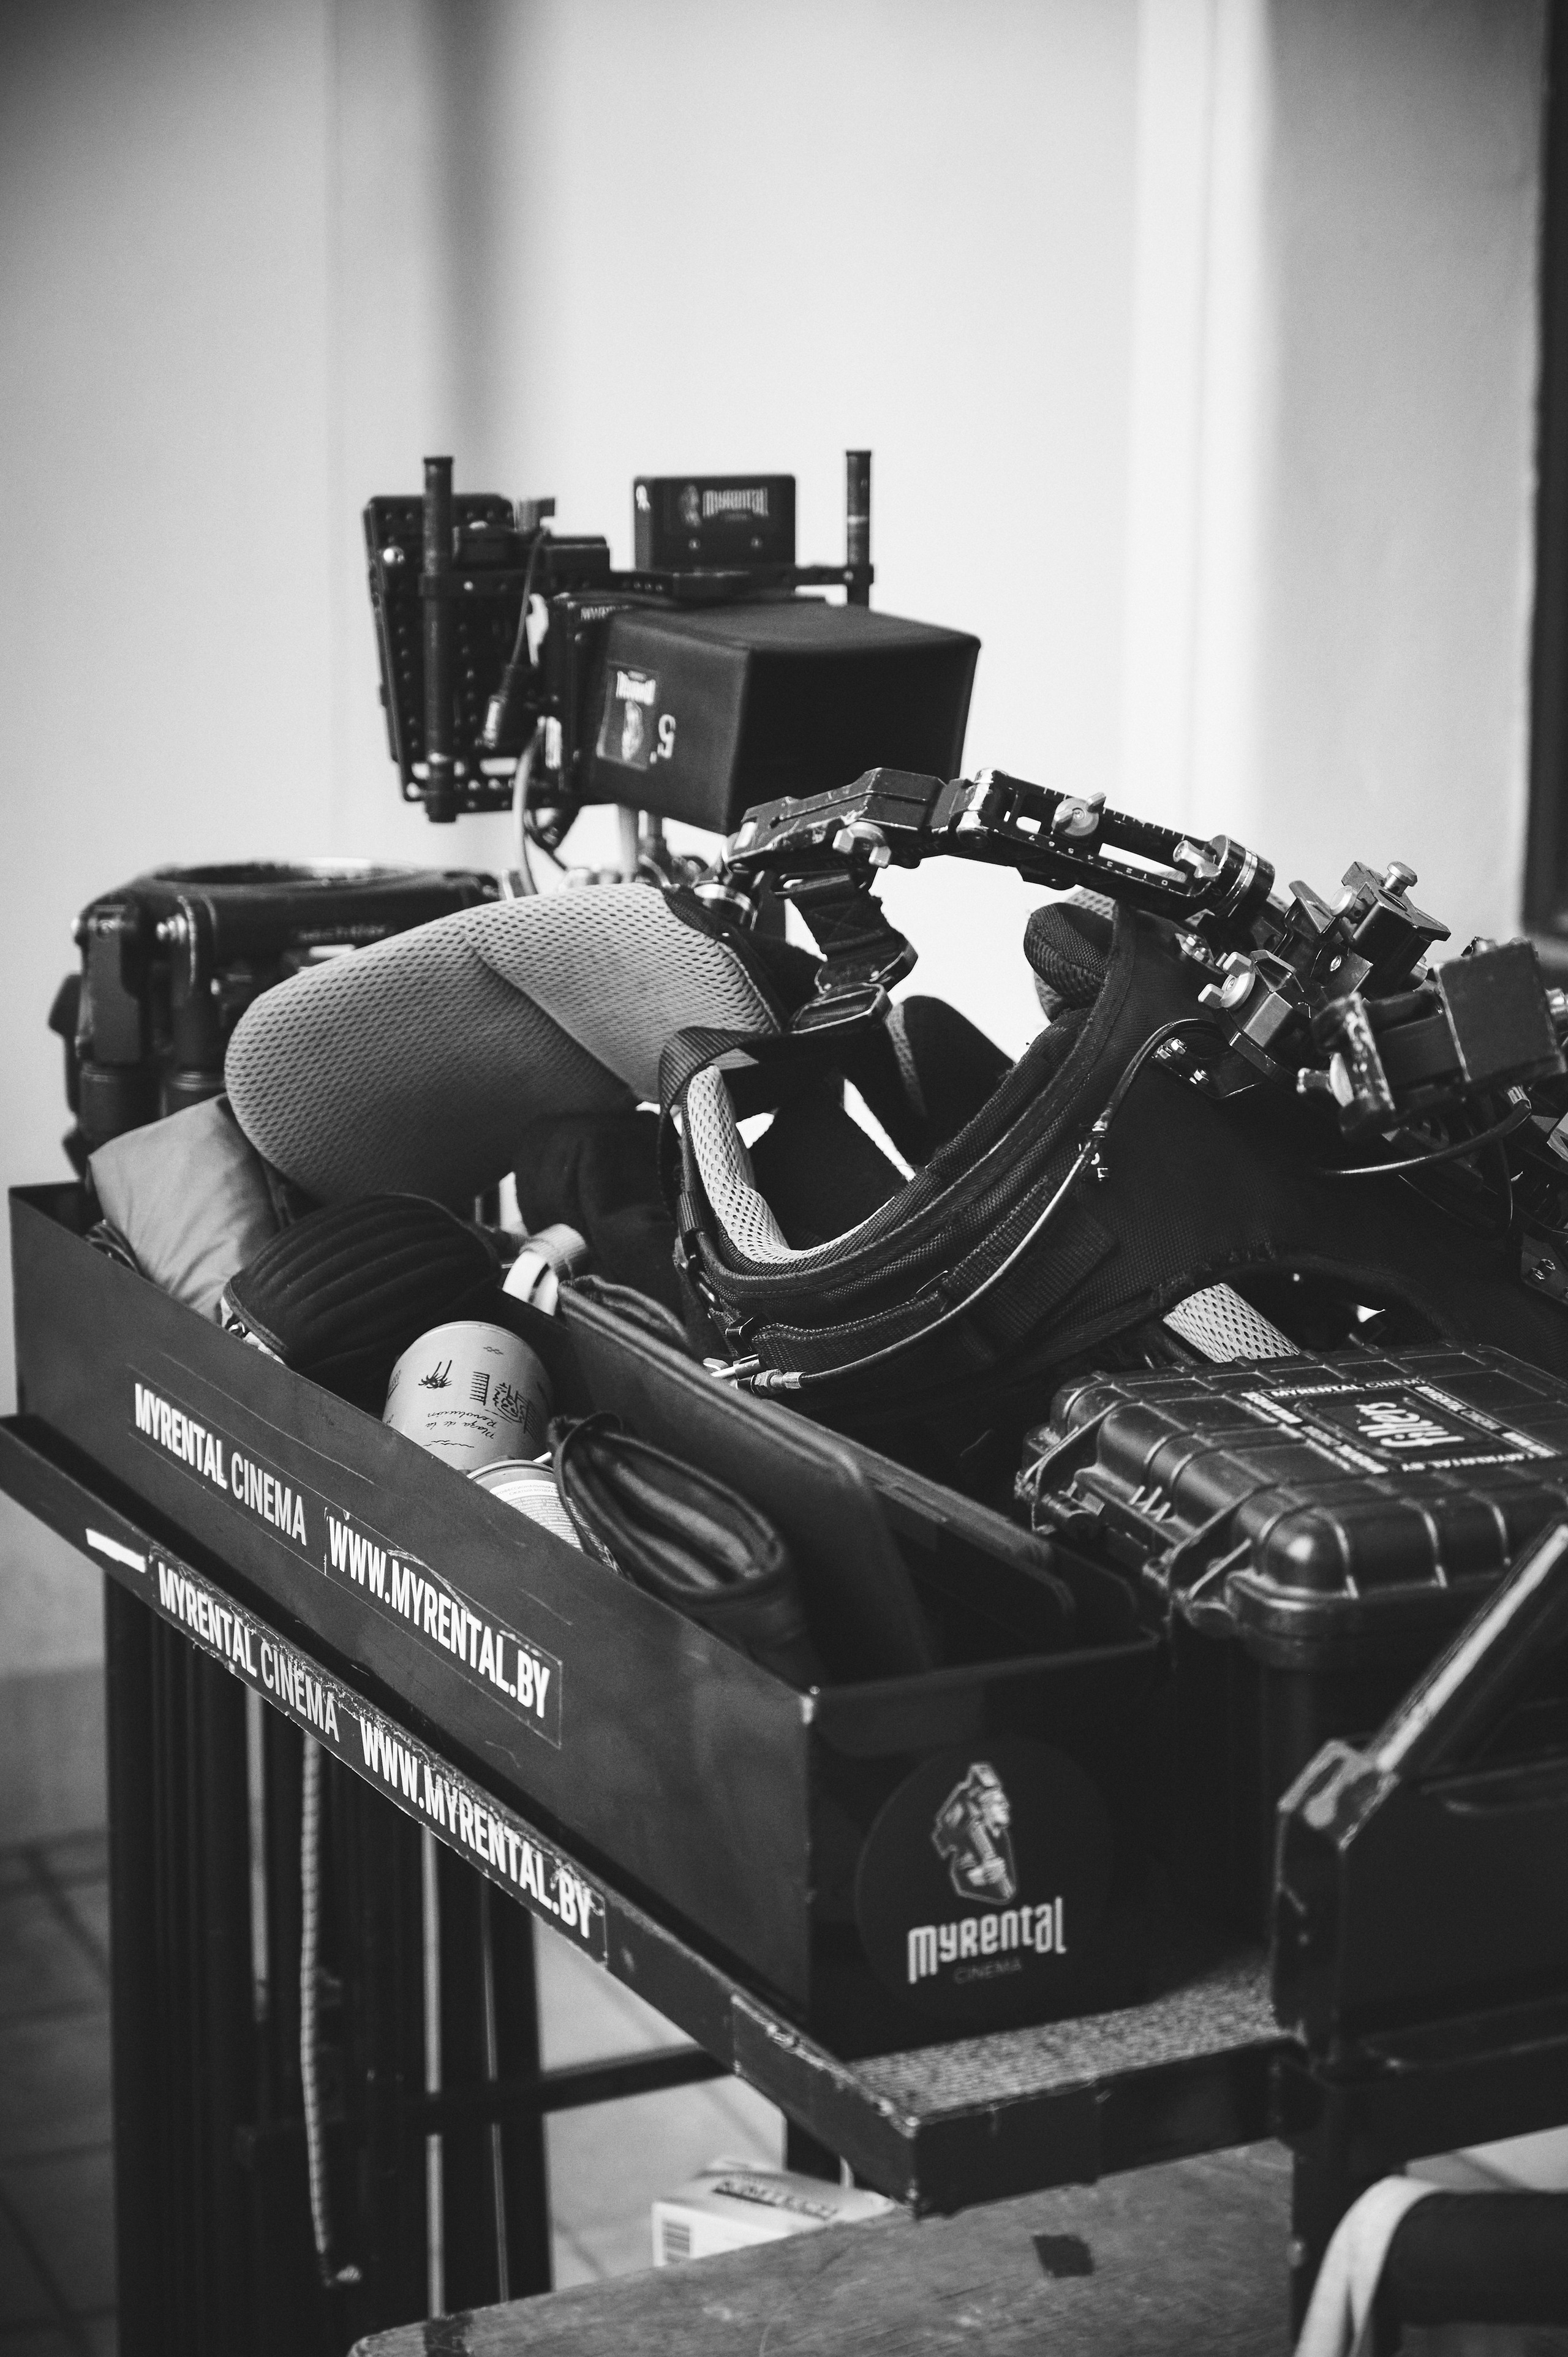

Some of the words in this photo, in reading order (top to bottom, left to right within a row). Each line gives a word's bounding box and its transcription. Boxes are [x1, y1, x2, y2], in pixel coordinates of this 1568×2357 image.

[134, 1382, 227, 1490] MYRENTAL
[231, 1452, 307, 1545] CINEMA
[328, 1515, 551, 1719] WWW.MYRENTAL.BY
[1365, 1378, 1426, 1388] CINEM
[157, 1562, 257, 1677] MYRENTAL
[260, 1642, 340, 1742] CINEMA
[358, 1717, 594, 1939] WWW.MYRENTAL.BY
